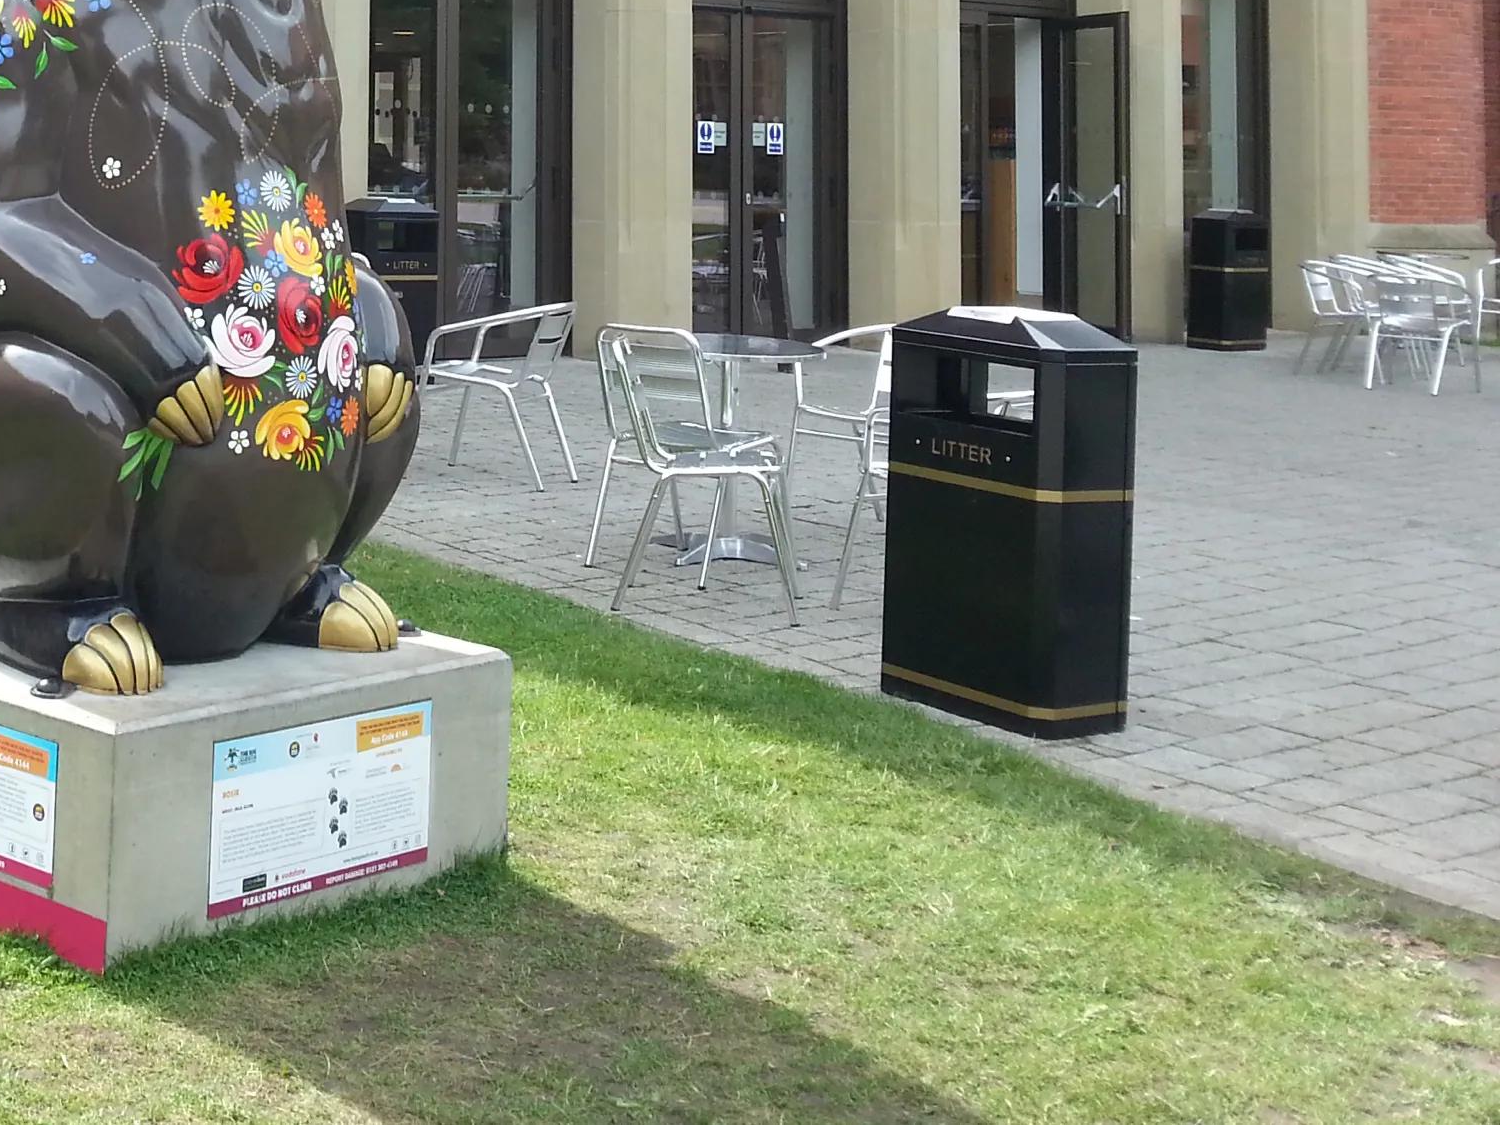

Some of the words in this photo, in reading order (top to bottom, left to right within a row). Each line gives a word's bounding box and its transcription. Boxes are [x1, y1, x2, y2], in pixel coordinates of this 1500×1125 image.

[393, 260, 420, 270] LITTER
[931, 438, 992, 465] LITTER
[242, 893, 267, 907] PLEASE
[267, 891, 277, 901] DO
[278, 887, 291, 898] NOT
[292, 881, 313, 894] CLIMB
